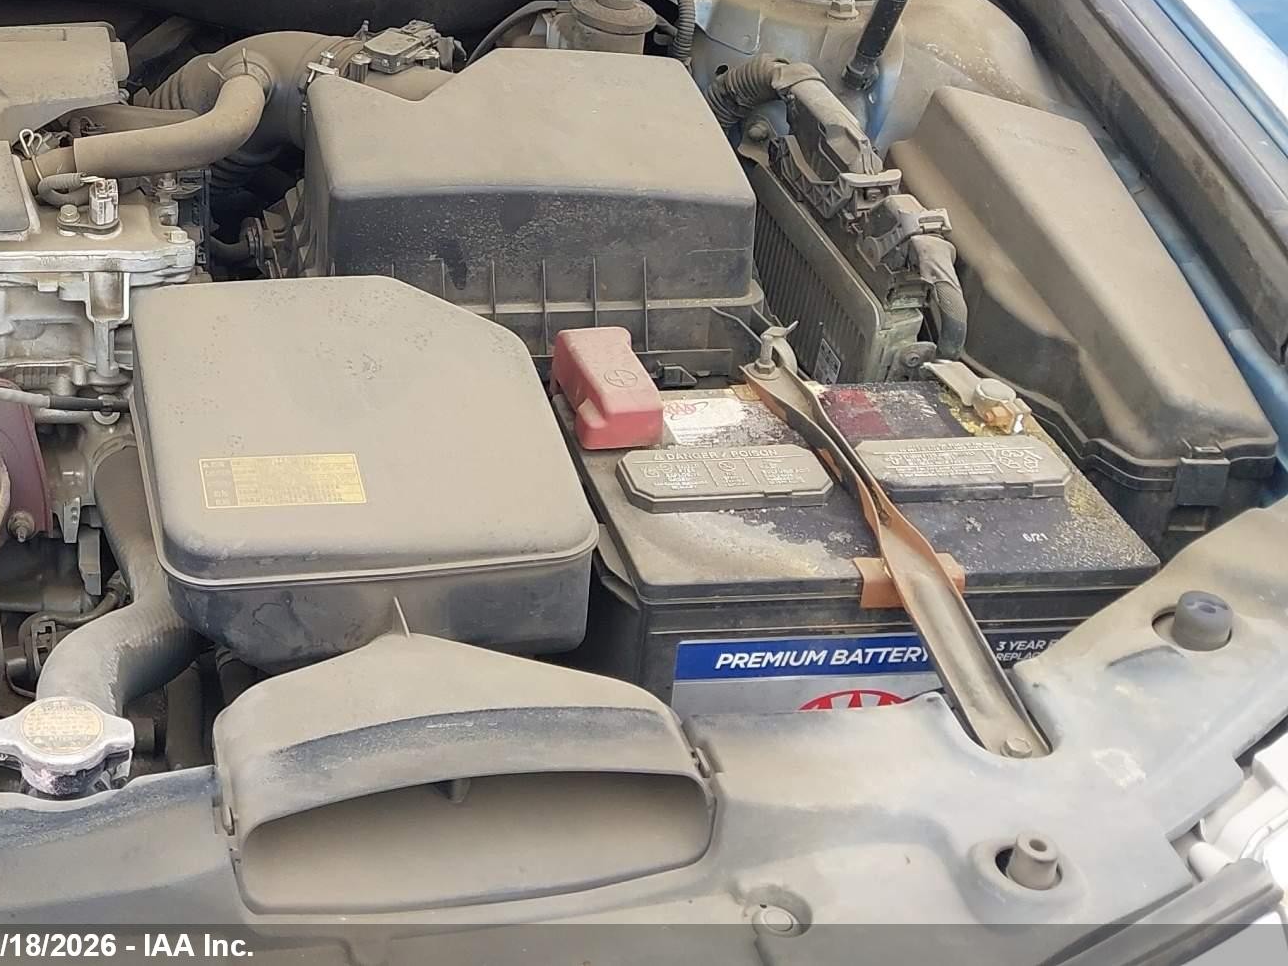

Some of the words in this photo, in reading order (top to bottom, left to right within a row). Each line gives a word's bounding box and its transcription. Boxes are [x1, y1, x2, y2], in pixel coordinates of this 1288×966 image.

[665, 450, 719, 461] DANGER
[730, 448, 777, 459] POISON
[996, 641, 1007, 652] 3
[1009, 639, 1046, 651] YEAR
[715, 649, 828, 669] PREMIUM
